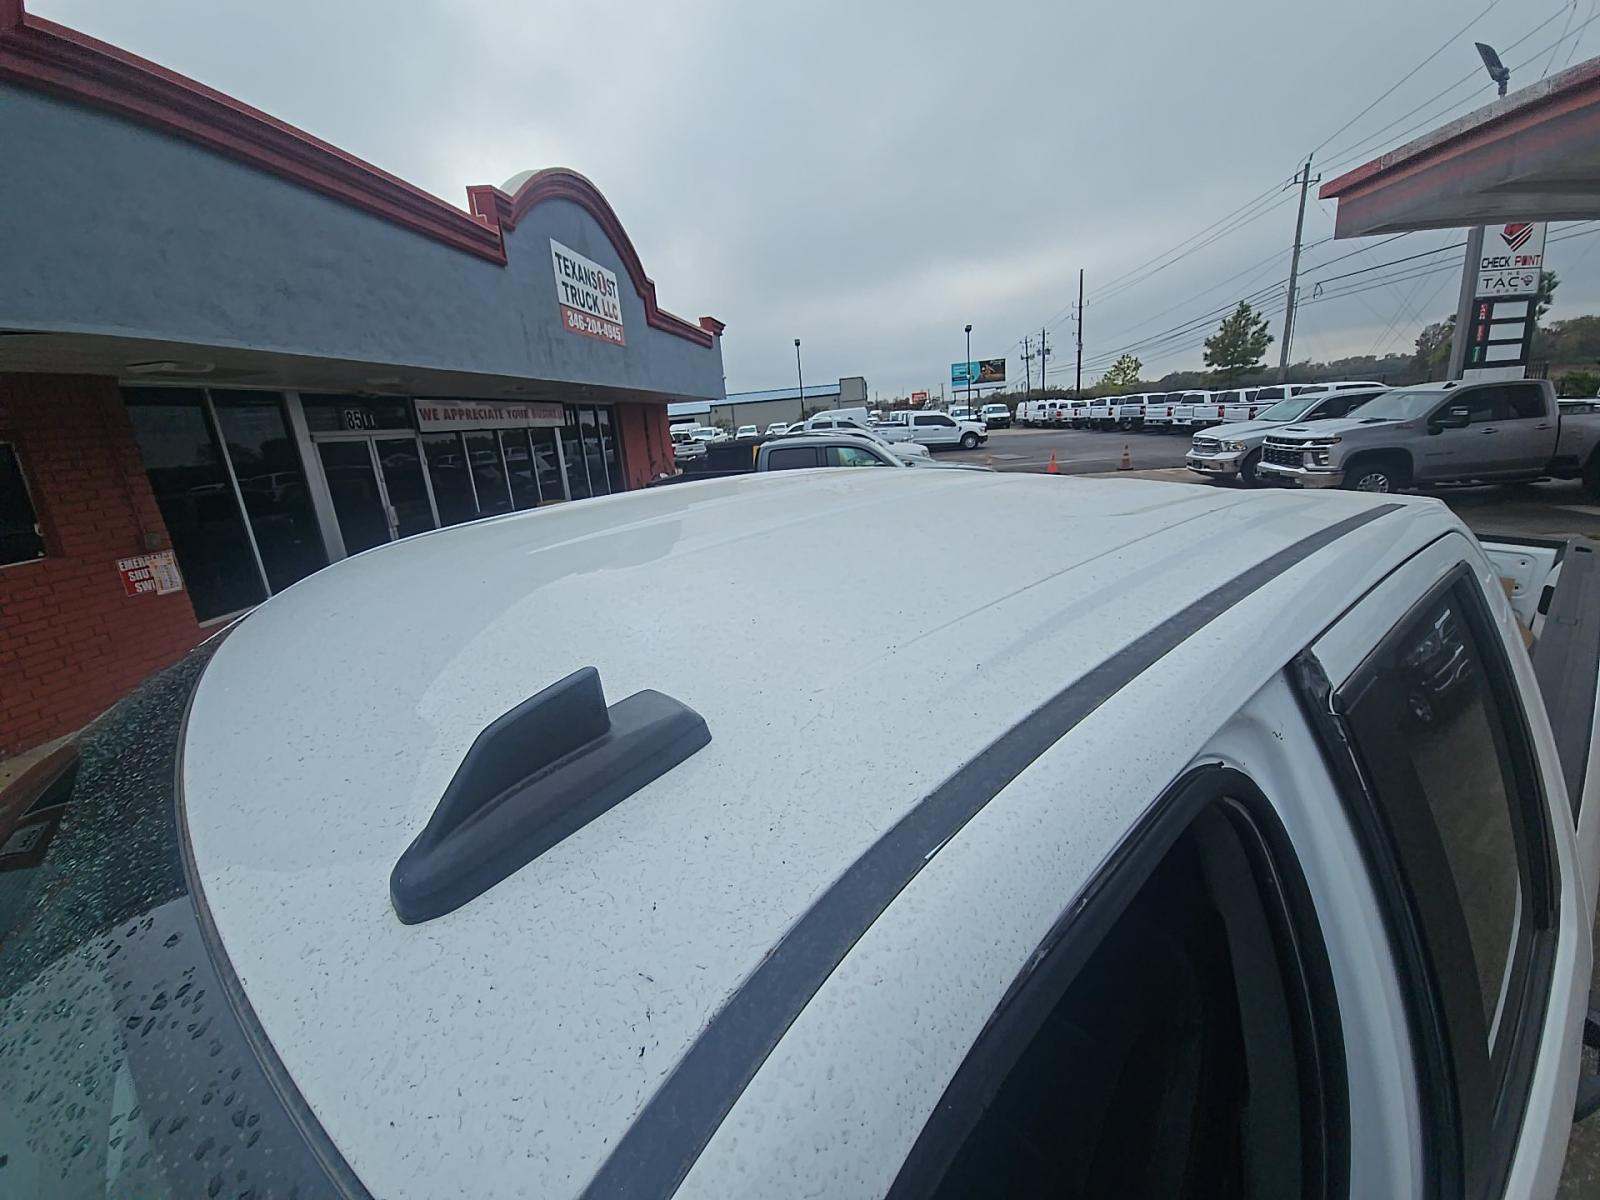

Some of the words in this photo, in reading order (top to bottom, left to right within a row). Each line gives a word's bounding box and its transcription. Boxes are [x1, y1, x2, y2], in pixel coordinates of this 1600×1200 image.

[554, 251, 598, 291] TEXANS
[1481, 256, 1511, 268] CHECK
[561, 281, 601, 314] TRUCK
[601, 300, 619, 321] LLC
[418, 407, 440, 421] WE
[443, 407, 504, 421] APPRECIATE
